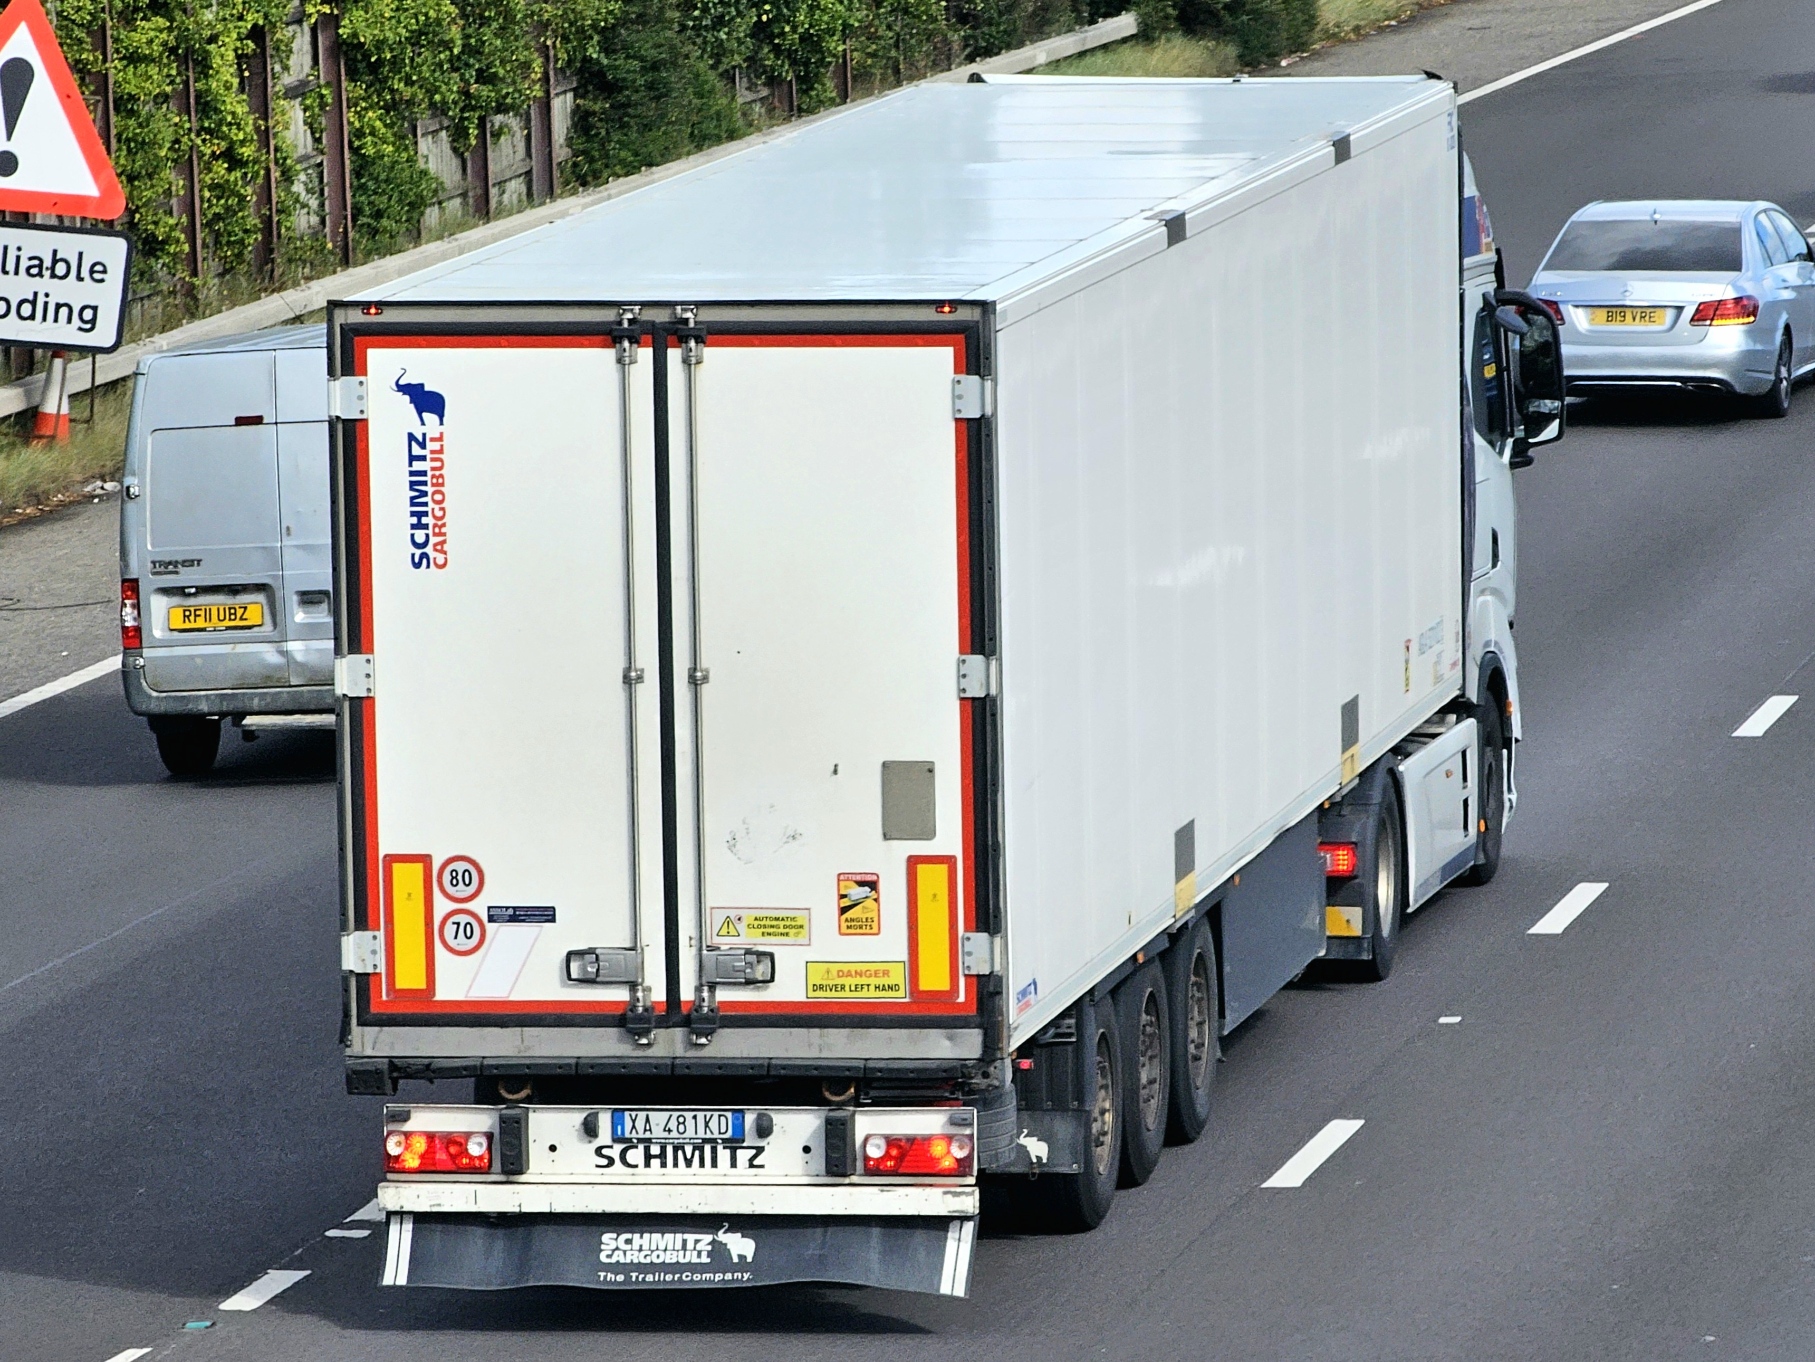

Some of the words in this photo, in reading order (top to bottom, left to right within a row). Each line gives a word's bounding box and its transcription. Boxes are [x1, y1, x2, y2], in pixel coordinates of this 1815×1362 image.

[1, 244, 108, 284] liable
[1606, 310, 1626, 323] B19
[1631, 311, 1657, 323] VRE
[407, 432, 431, 570] SCHMITZ
[428, 432, 448, 570] CARGOBULL
[182, 607, 212, 624] RF11
[217, 606, 248, 622] UBZ
[449, 868, 473, 888] 80
[451, 921, 474, 940] 70
[836, 969, 890, 979] DANGER
[812, 983, 846, 993] DRIVER
[848, 983, 872, 993] LEFT
[874, 983, 901, 993] HAND
[629, 1113, 653, 1135] XA
[662, 1113, 730, 1135] 481KD
[594, 1144, 766, 1169] SCHMITZ
[600, 1232, 714, 1251] SCHMITZ
[599, 1250, 711, 1264] CARGOBULL
[597, 1271, 625, 1282] The
